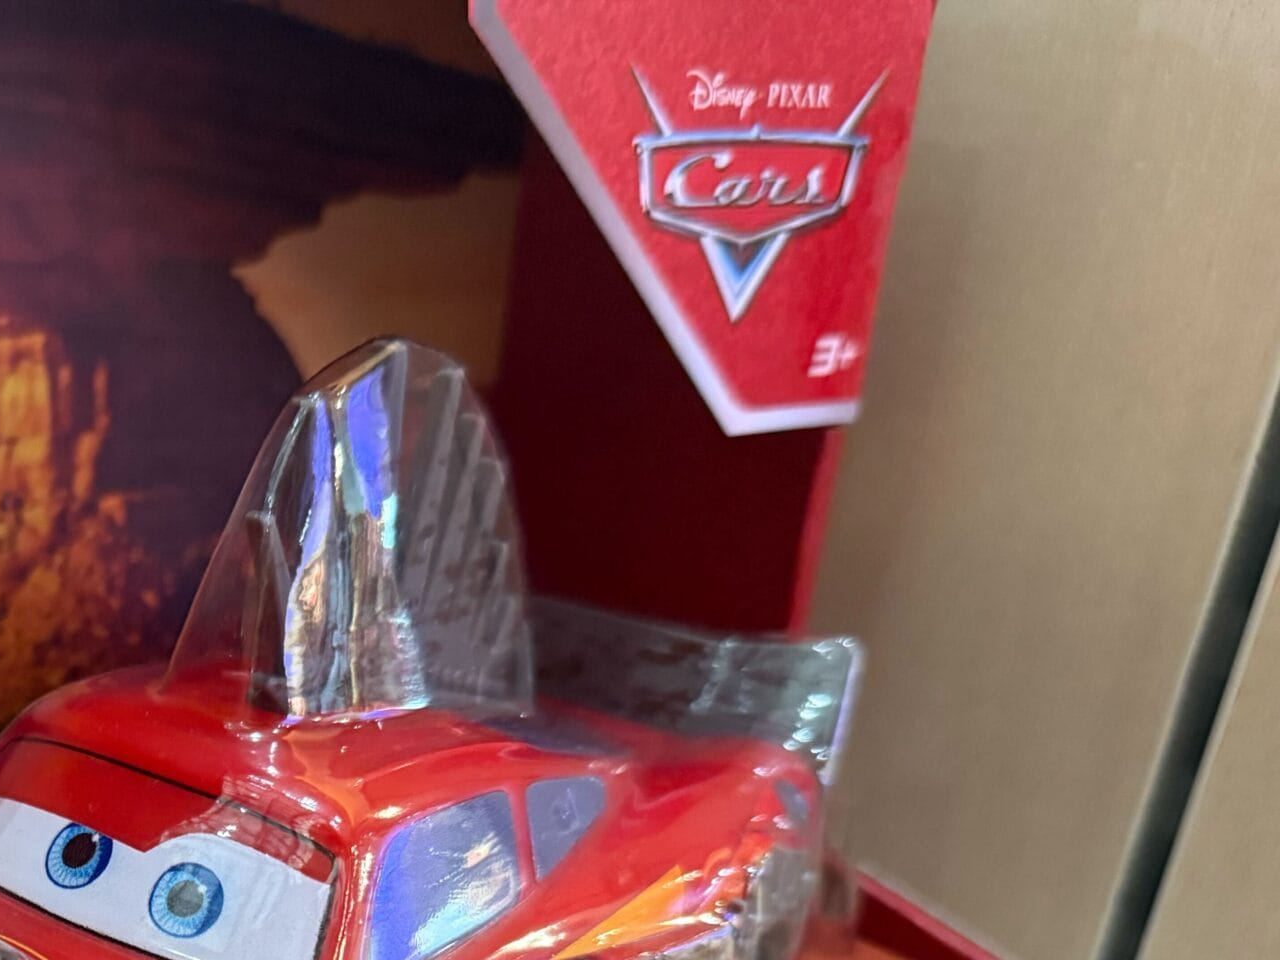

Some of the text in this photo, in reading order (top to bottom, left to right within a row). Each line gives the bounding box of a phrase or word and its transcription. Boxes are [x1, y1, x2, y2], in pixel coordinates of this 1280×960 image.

[686, 68, 831, 120] Disney PIXAR
[663, 149, 825, 208] Cars
[807, 332, 858, 378] 3+
